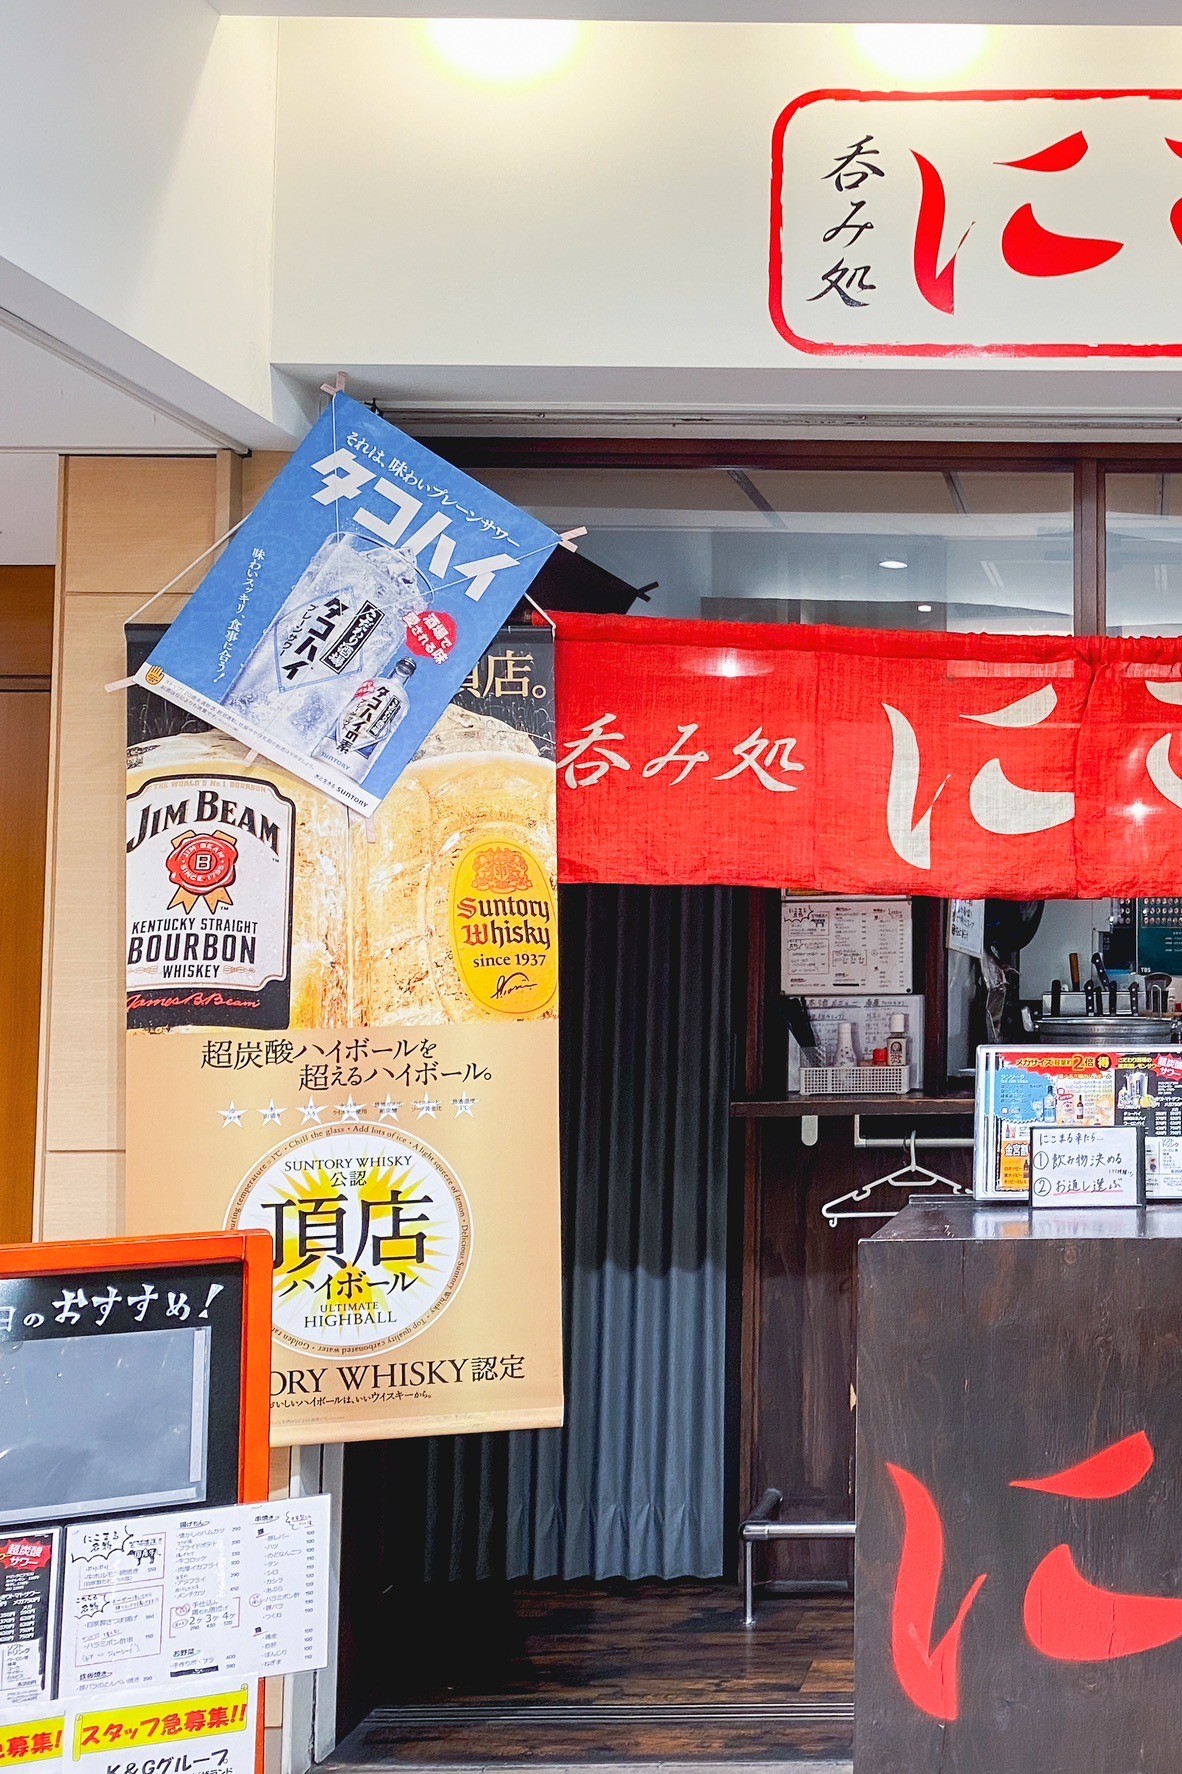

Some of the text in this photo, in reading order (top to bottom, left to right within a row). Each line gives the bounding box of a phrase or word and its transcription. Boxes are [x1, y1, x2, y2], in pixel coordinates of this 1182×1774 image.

[806, 134, 885, 308] 呑み処
[346, 431, 521, 548] それは、味わいプレーンサワー
[310, 447, 521, 602] タコハイ
[282, 597, 349, 681] タコハイ
[402, 611, 448, 666] 愛される味
[422, 612, 452, 649] 酒場で
[320, 751, 351, 772] SUNTORY
[556, 712, 806, 793] 呑み処
[336, 786, 369, 809] SUNTORY
[126, 789, 281, 857] JIM BEAM
[195, 853, 212, 871] B
[456, 897, 550, 923] Suntory
[132, 917, 259, 935] KENTUCKY STRAIGHT
[462, 922, 552, 950] Whisky
[127, 932, 257, 966] BOURBON
[472, 953, 547, 969] since 1937
[162, 964, 221, 979] WHISKEY
[200, 1038, 438, 1071] 超炭酸ハイボールを
[298, 1061, 493, 1091] 超えるハイボール。
[310, 1129, 323, 1139] the
[325, 1126, 345, 1136] glass
[371, 1125, 385, 1136] lots
[395, 1133, 407, 1143] ice
[288, 1135, 309, 1149] Chill
[284, 1154, 414, 1173] SUNTORY WHISKY
[418, 1146, 435, 1163] light
[1052, 1152, 1123, 1170] 飲み物決める
[330, 1170, 368, 1188] 公認
[433, 1160, 453, 1186] squeeze
[238, 1165, 267, 1206] temperature
[1055, 1177, 1123, 1193] お通し選ぶ
[454, 1194, 466, 1217] lemon
[260, 1189, 433, 1274] 頂店
[459, 1224, 469, 1260] Delicious
[278, 1271, 420, 1300] ハイボール
[448, 1260, 465, 1291] Suntory
[319, 1300, 380, 1313] ULTIMATE
[430, 1291, 452, 1314] Whisky
[303, 1310, 398, 1329] HIGHBALL
[412, 1318, 429, 1330] Top
[283, 1334, 311, 1350] Golden
[387, 1327, 412, 1345] quality
[318, 1346, 340, 1354] water
[341, 1340, 386, 1355] carbonated
[7, 1543, 43, 1557] 超炭酸
[9, 1556, 39, 1567] サワー
